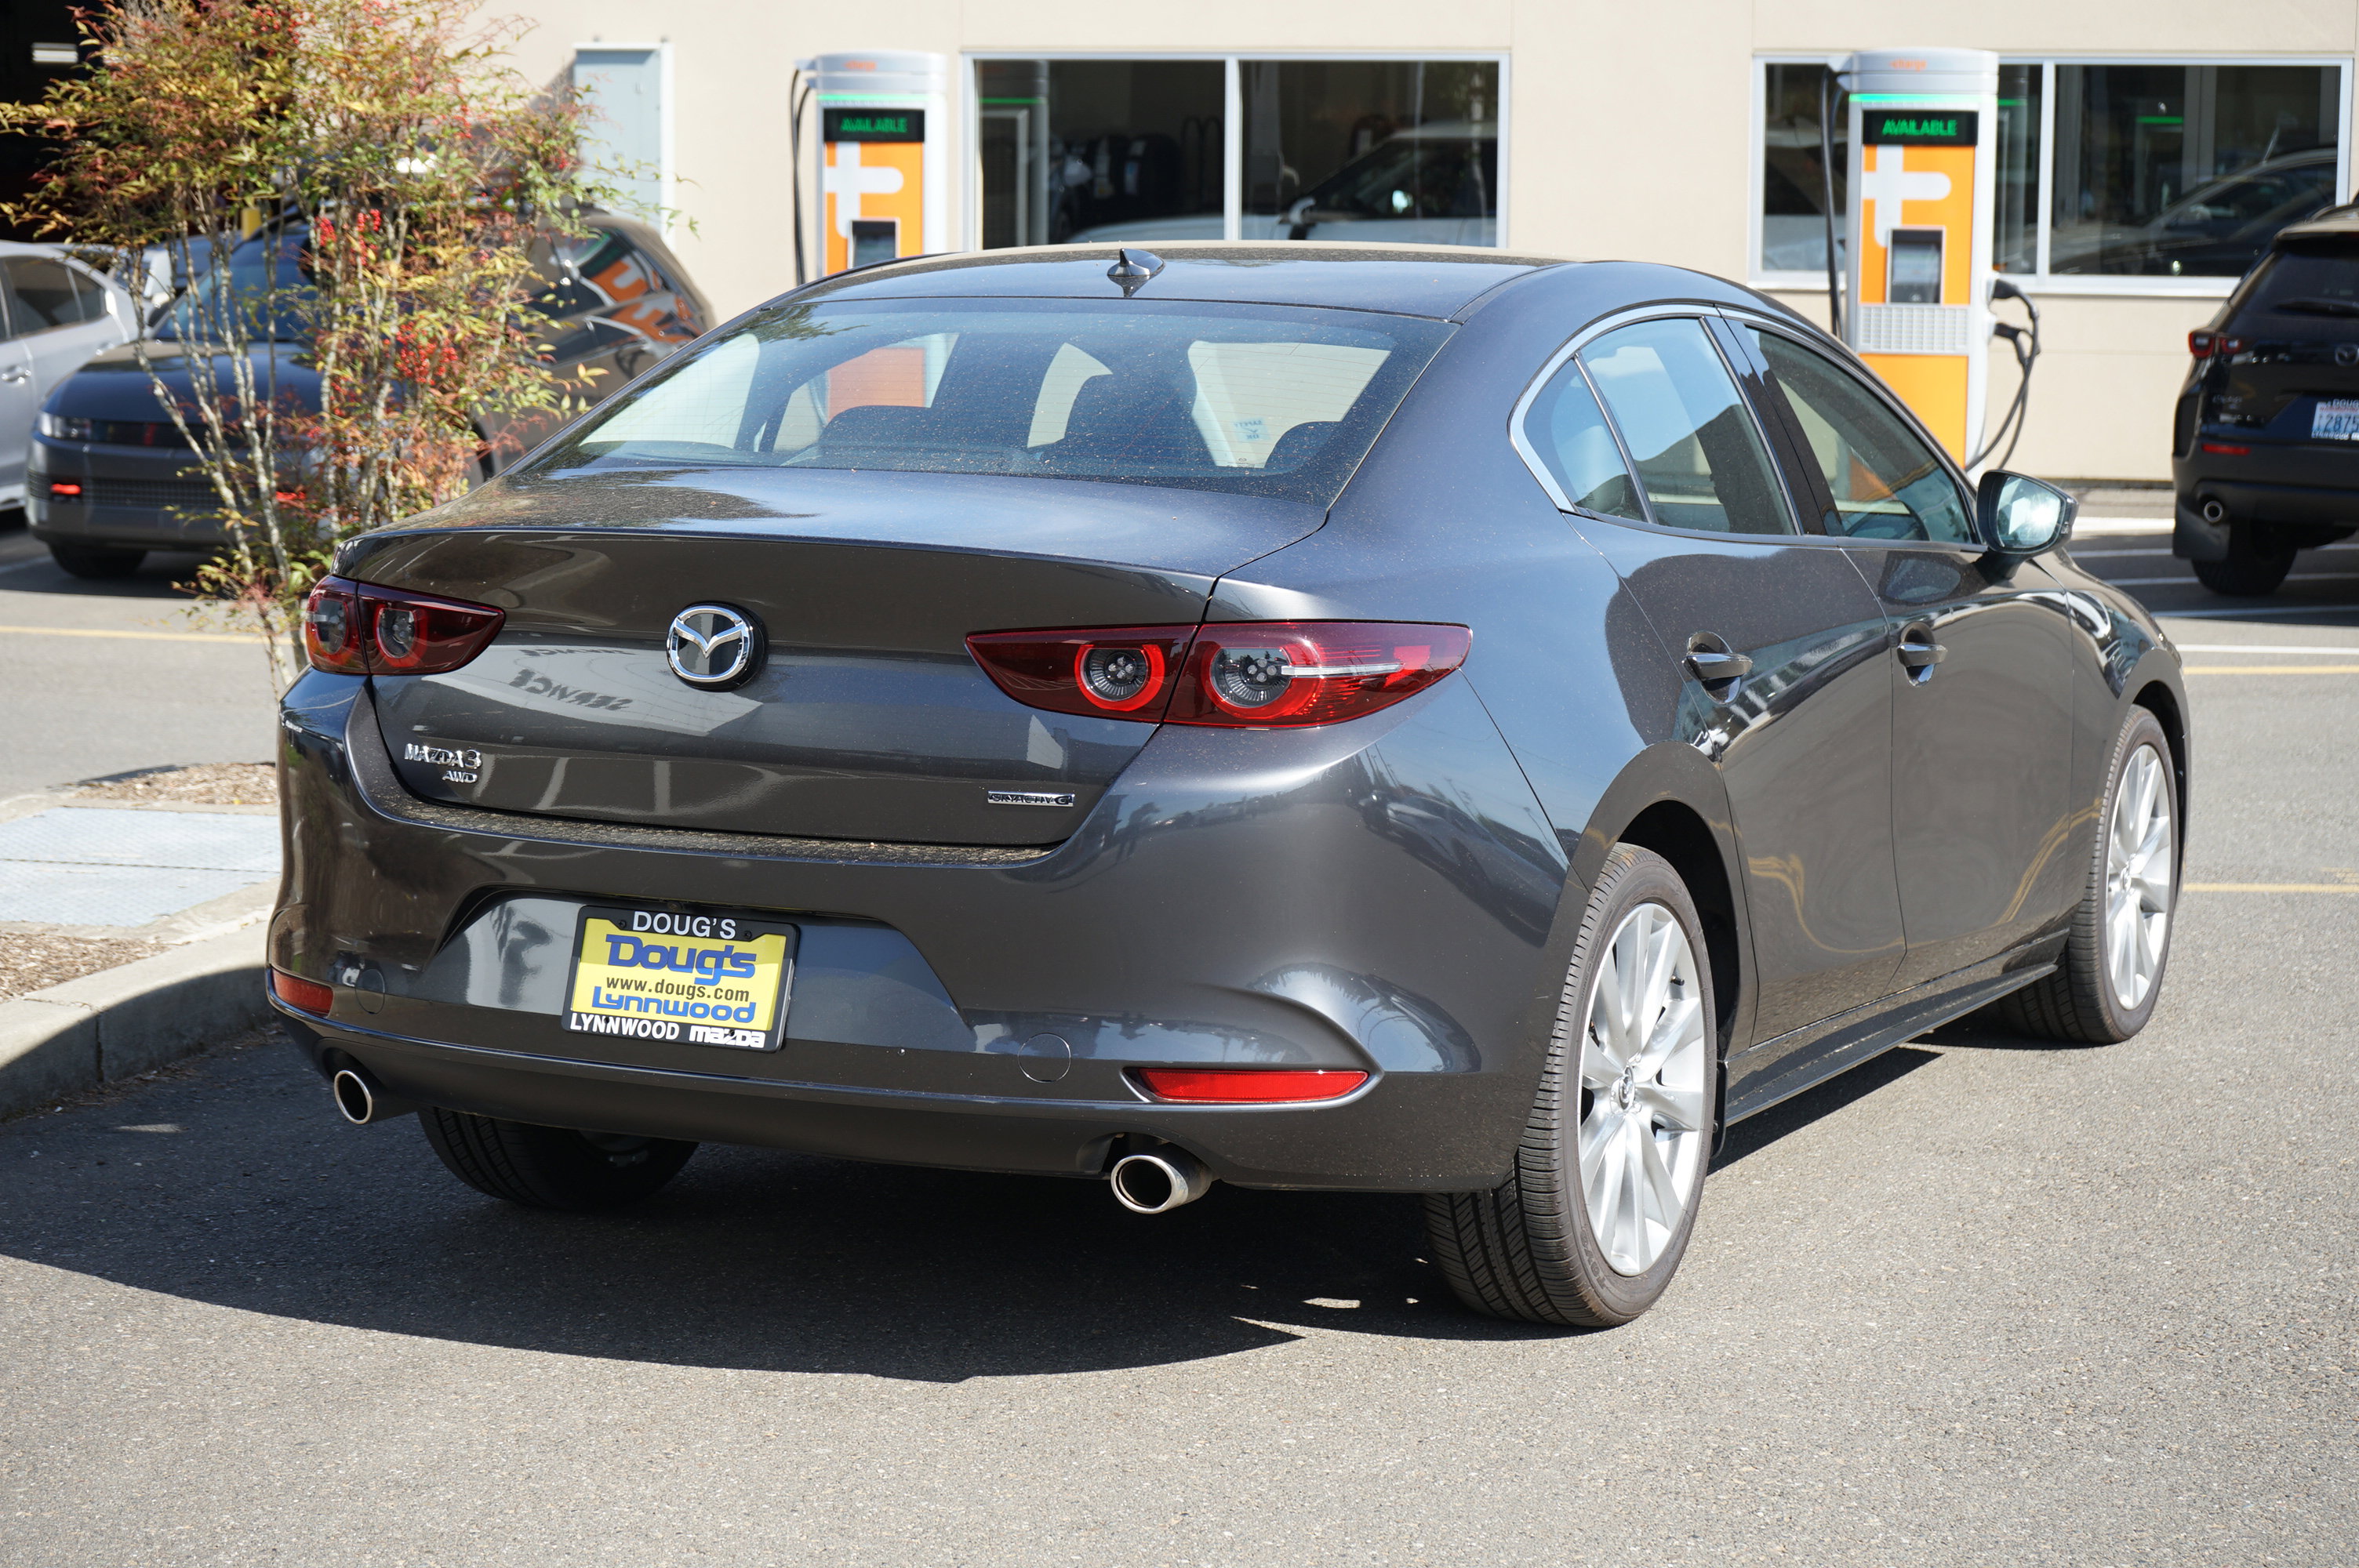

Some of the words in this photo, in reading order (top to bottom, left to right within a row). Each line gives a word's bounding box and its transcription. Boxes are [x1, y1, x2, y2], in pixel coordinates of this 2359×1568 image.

[840, 118, 907, 132] AVAILABLE
[1882, 119, 1957, 136] AVAILABLE
[405, 742, 482, 770] MAZDA3
[442, 771, 478, 783] AWD
[632, 910, 737, 940] DOUG'S
[605, 933, 758, 986] Doug's
[605, 977, 751, 1002] www.dougs.com
[591, 985, 757, 1023] Lynnwood
[569, 1012, 680, 1040] LYNNWOOD
